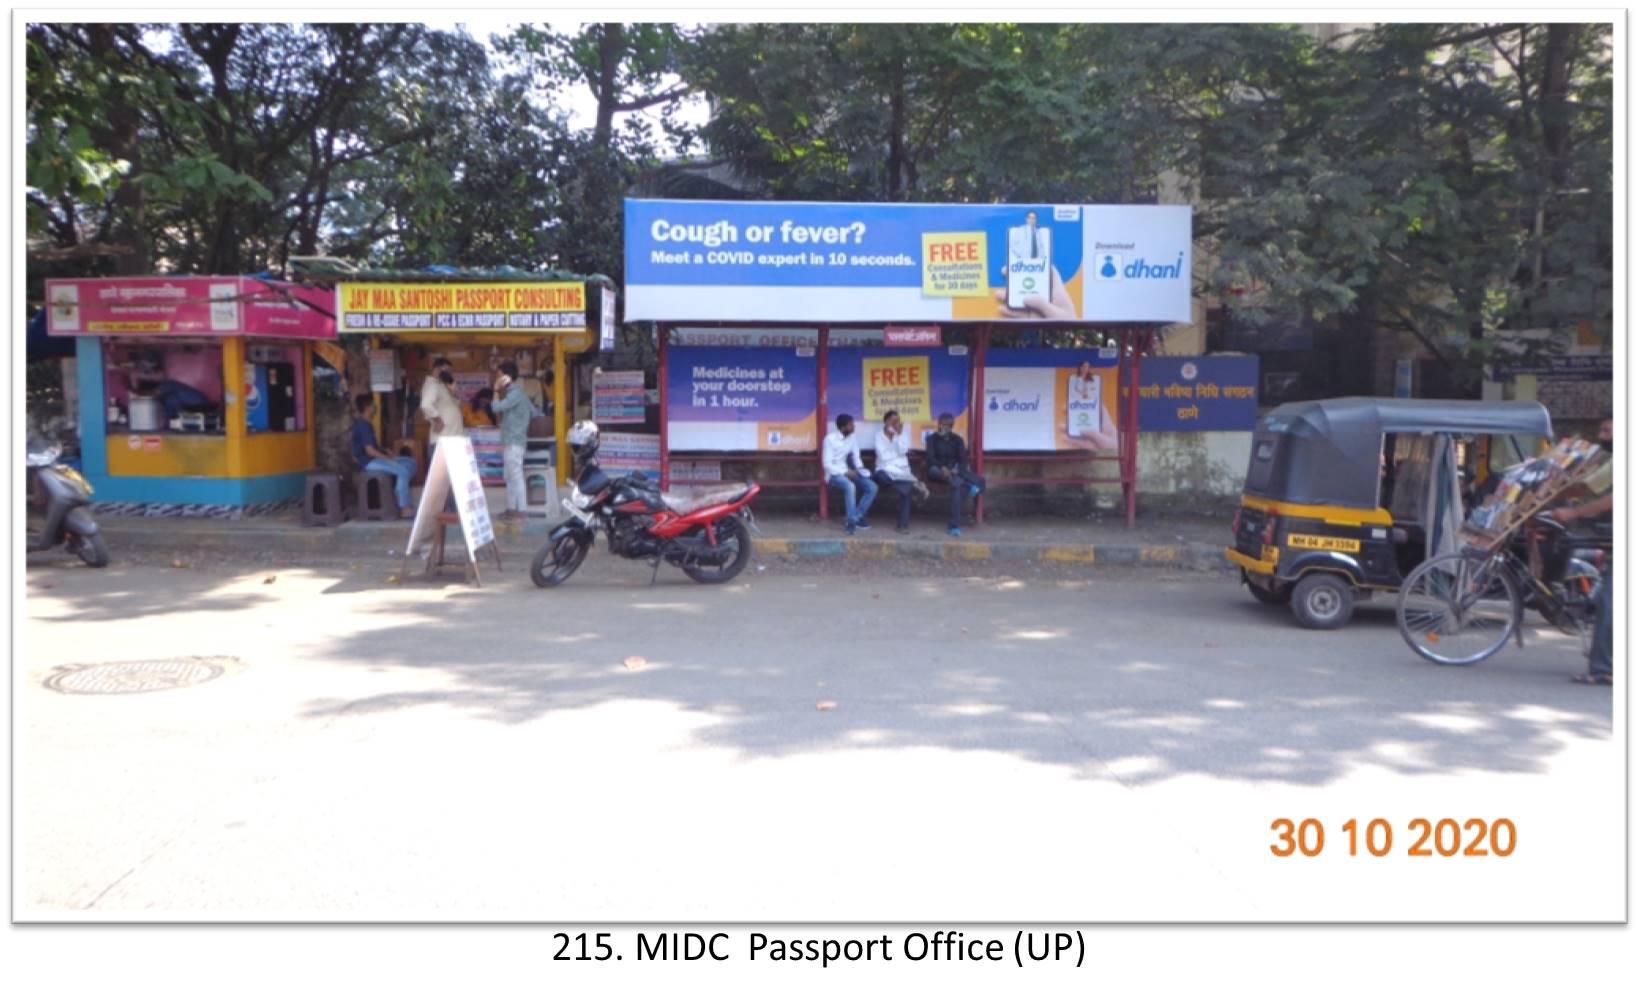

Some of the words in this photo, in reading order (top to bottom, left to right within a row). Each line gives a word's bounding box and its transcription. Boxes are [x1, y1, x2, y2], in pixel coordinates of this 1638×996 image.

[651, 219, 738, 247] Cough
[745, 225, 774, 243] or
[780, 220, 867, 244] fever?
[651, 250, 690, 264] Meet
[694, 253, 704, 264] a
[707, 251, 754, 265] COVID
[757, 252, 807, 267] expert
[810, 252, 825, 265] in
[829, 253, 847, 265] 10
[850, 252, 917, 266] seconds.
[930, 241, 979, 262] FREE
[927, 263, 982, 273] Consultations
[1011, 256, 1046, 273] dhani
[1124, 251, 1184, 280] dhani
[931, 273, 938, 281] &
[940, 272, 980, 280] Medicines
[934, 282, 945, 290] for
[960, 281, 977, 291] days
[350, 287, 369, 309] JAY
[372, 287, 397, 309] MAA
[400, 287, 453, 309] SANTOSHI
[456, 287, 510, 309] PASSPORT
[514, 286, 582, 309] CONSULTING
[401, 313, 432, 328] PASSPORT
[475, 313, 504, 328] PASSPORT
[692, 366, 765, 380] Medicines
[769, 367, 784, 380] at
[870, 365, 921, 387] FREE
[692, 381, 724, 394] your
[727, 380, 792, 394] doorstep
[692, 394, 707, 408] in
[710, 395, 720, 408] 1
[723, 394, 759, 408] hour.
[1003, 394, 1040, 411] dhani
[1070, 397, 1098, 410] dhani
